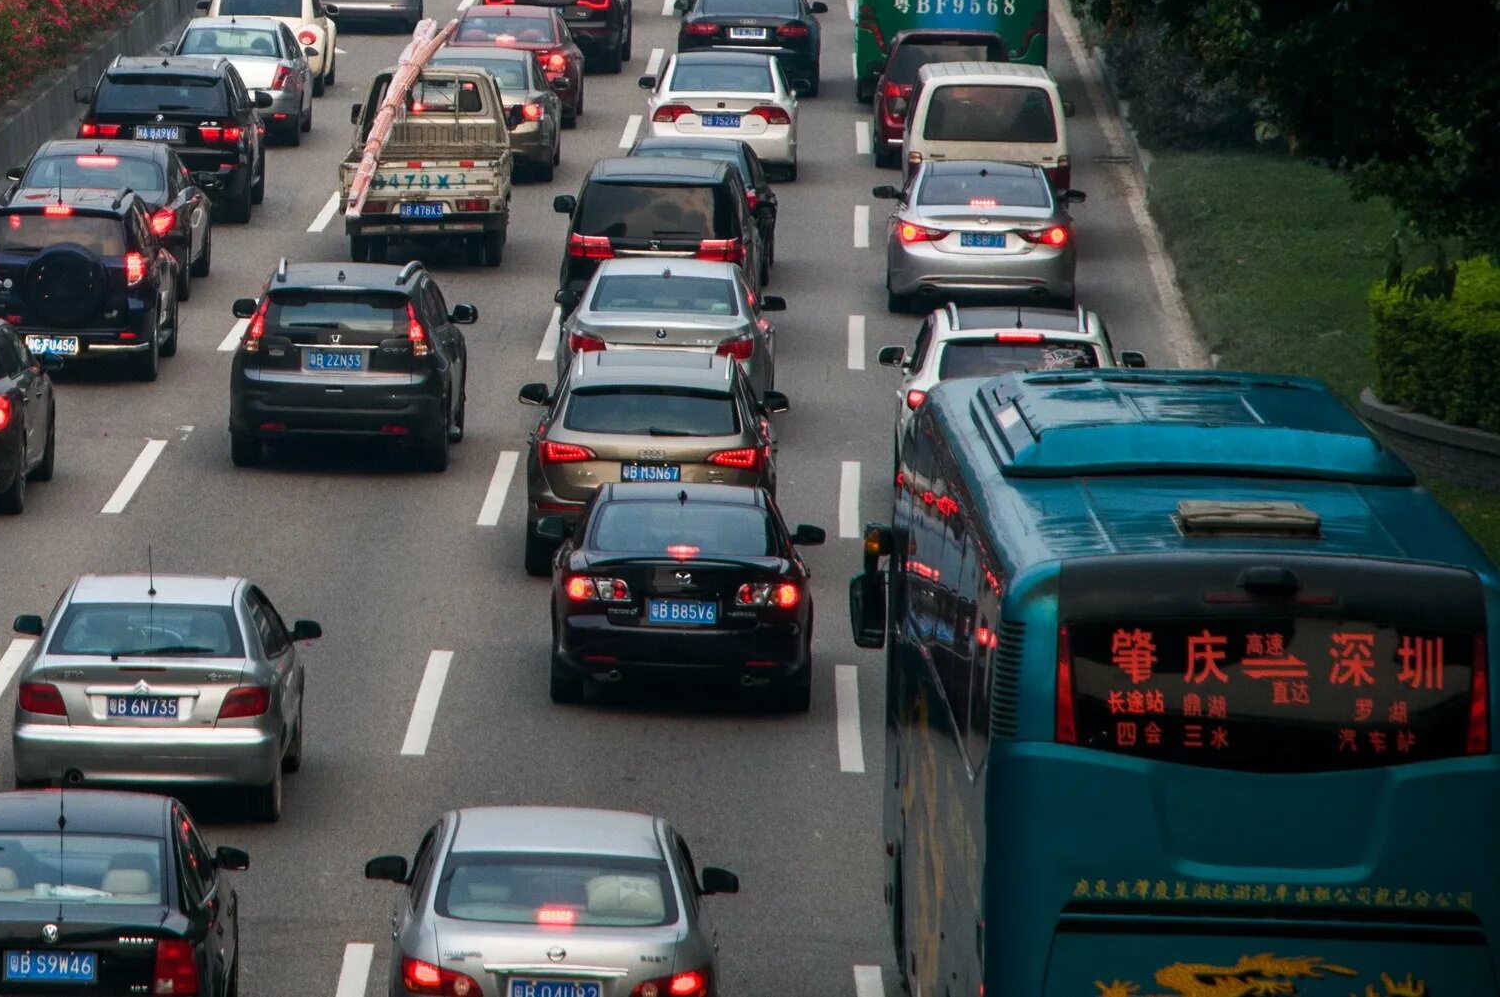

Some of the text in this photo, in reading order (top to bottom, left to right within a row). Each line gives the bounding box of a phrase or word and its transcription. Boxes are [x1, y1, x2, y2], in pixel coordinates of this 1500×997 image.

[414, 205, 442, 216] 478X3
[44, 338, 76, 352] FU456
[326, 352, 362, 366] 2ZN33
[641, 466, 679, 479] M3N67
[671, 606, 714, 620] B85V6
[1246, 633, 1284, 654] 高速
[1112, 629, 1444, 689] 肇庆 深圳
[1108, 690, 1165, 715] 长途站
[1273, 681, 1311, 704] 直达
[131, 699, 177, 714] 6N735
[1183, 693, 1227, 718] 鼎湖
[1354, 699, 1408, 723] 罗湖
[1117, 722, 1162, 746] 四会
[1184, 725, 1229, 749] 三水
[1339, 729, 1416, 753] 汽车站
[36, 956, 92, 974] S9W46
